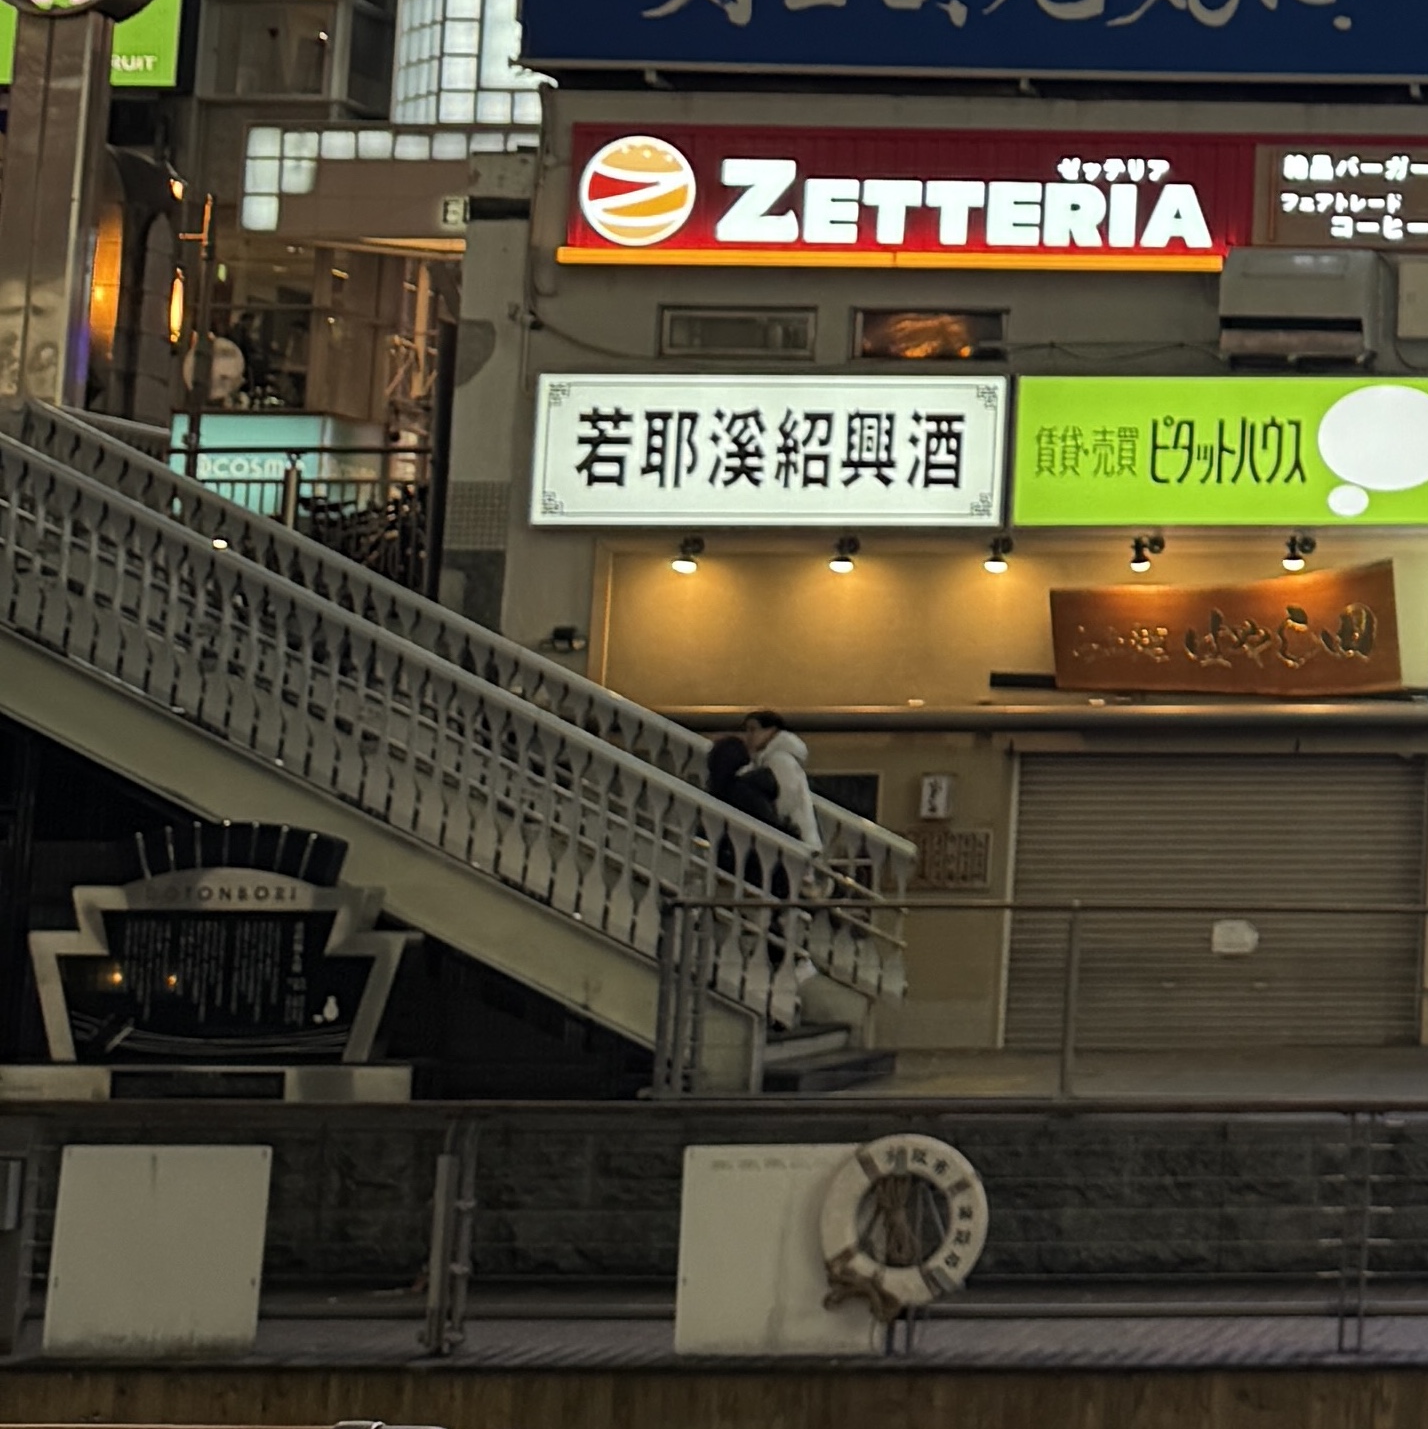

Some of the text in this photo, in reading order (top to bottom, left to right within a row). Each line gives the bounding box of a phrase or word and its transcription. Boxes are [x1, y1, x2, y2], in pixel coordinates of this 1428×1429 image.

[715, 158, 1213, 249] ZETTERIA
[1056, 156, 1171, 182] ゼッテリア
[1034, 415, 1307, 484] 賃貸・売買 ピタットハウス
